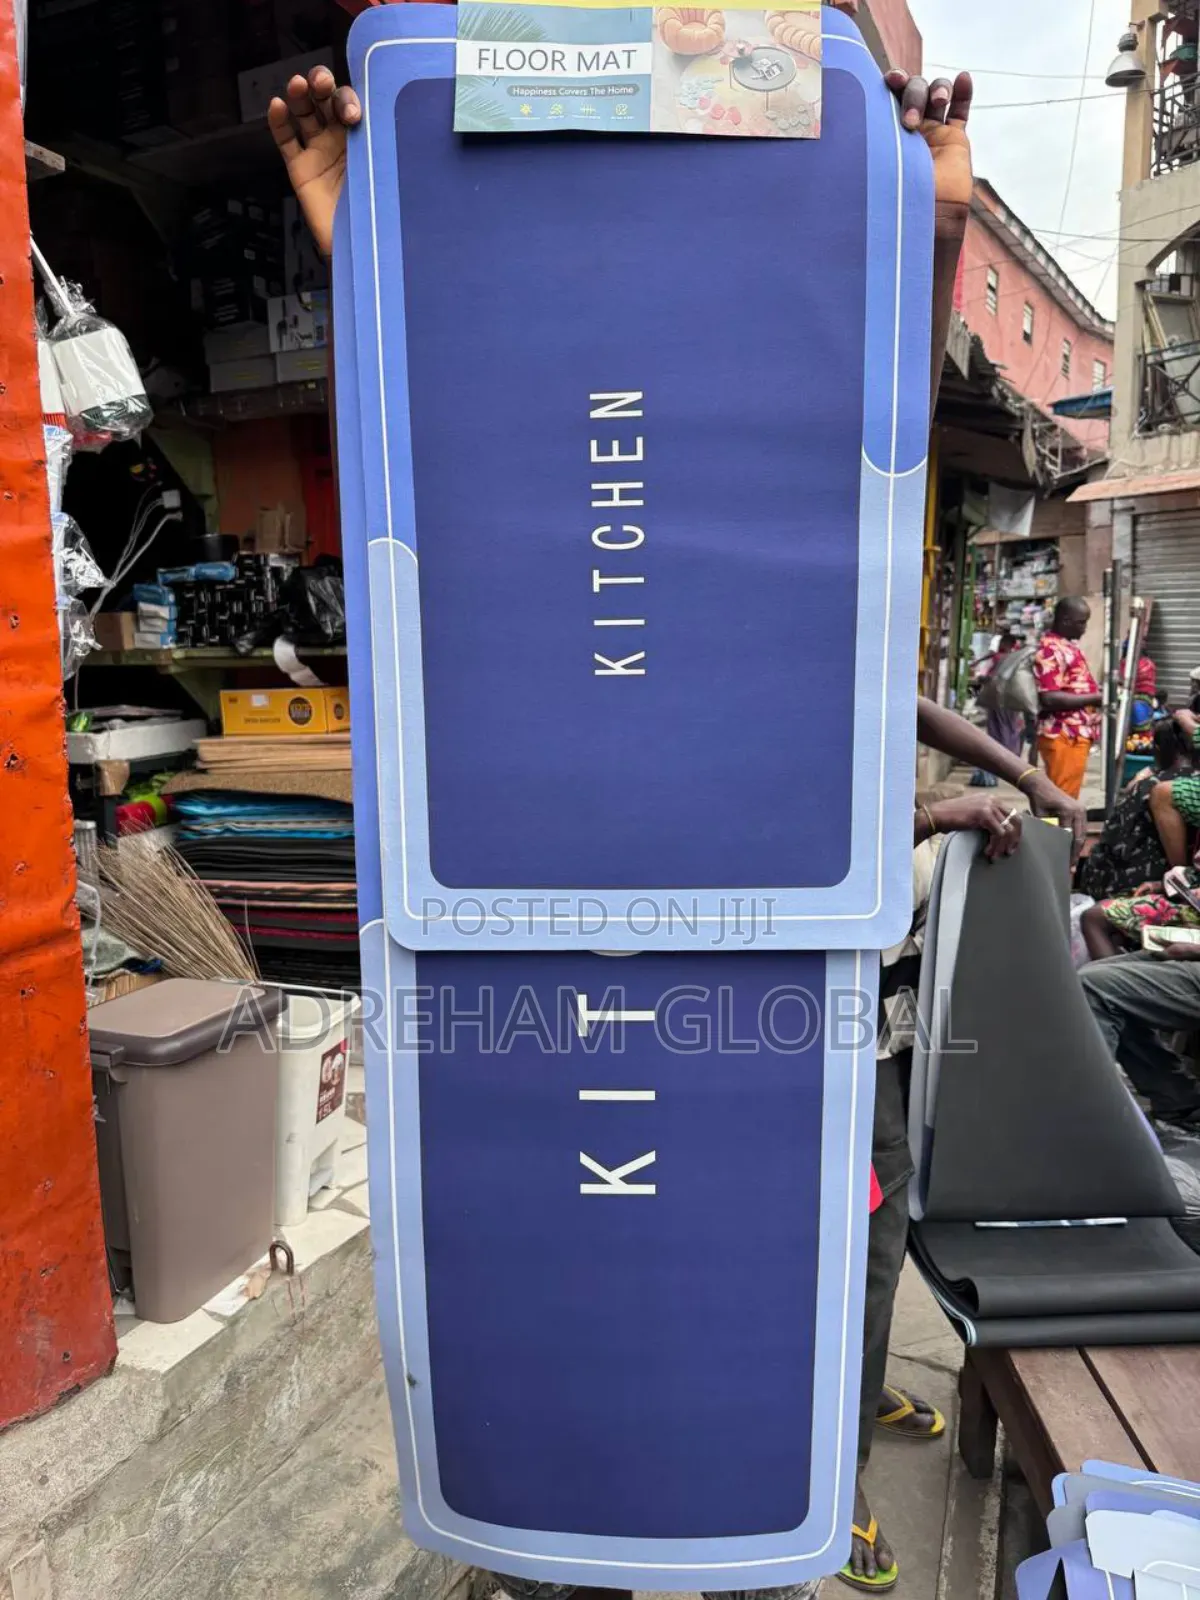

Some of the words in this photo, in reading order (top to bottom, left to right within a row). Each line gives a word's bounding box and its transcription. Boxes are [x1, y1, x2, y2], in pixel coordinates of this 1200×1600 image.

[478, 48, 567, 71] FLOOR
[577, 49, 637, 72] MAT
[512, 86, 556, 97] Happiness
[559, 87, 588, 96] Covers
[590, 86, 605, 95] The
[607, 85, 634, 95] Home
[589, 391, 646, 676] KITCHEN
[577, 949, 656, 1195] KIT
